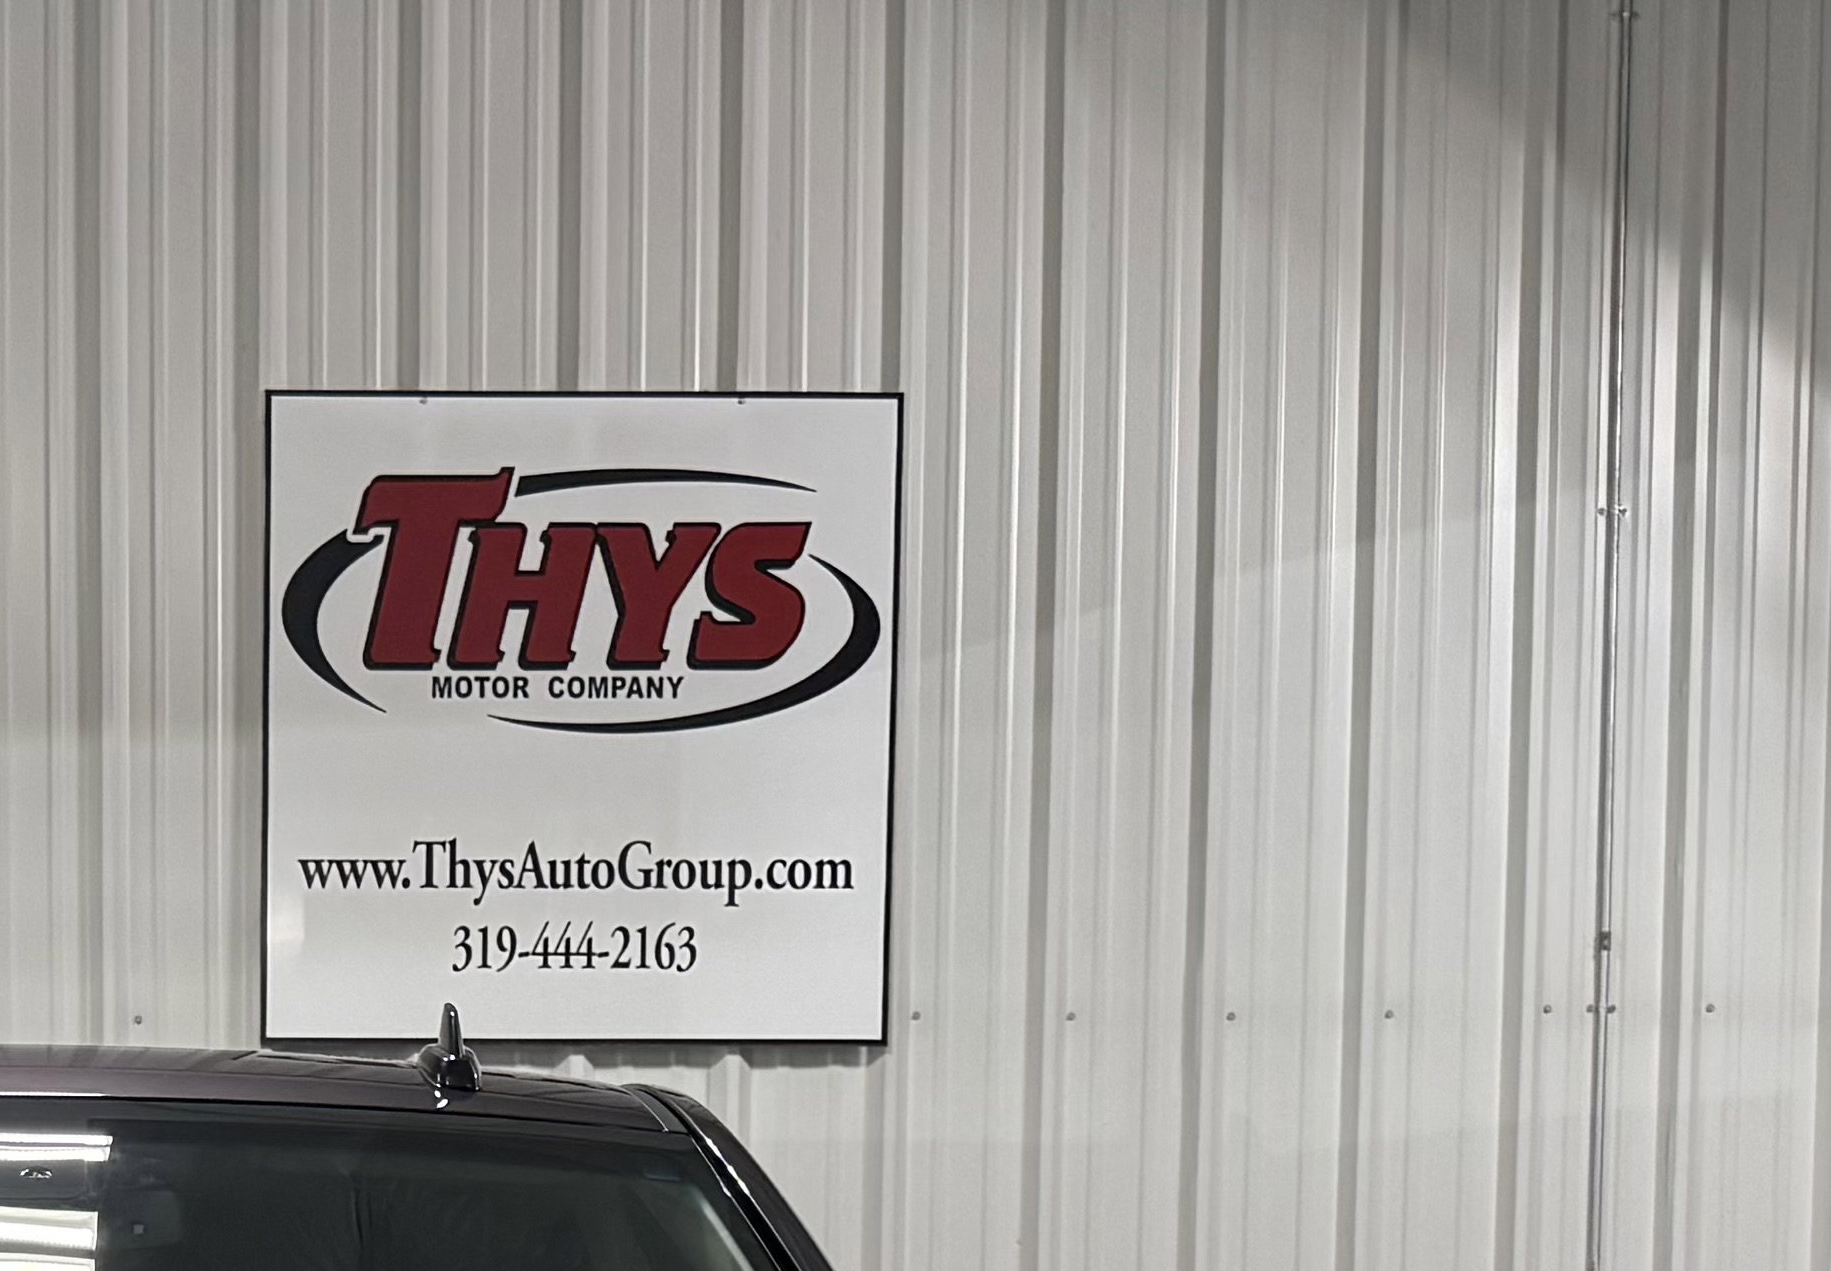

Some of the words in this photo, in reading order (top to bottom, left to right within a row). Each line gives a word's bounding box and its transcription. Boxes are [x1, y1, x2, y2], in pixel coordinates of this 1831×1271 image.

[352, 467, 812, 671] THYS
[431, 676, 530, 700] MOTOR
[548, 675, 685, 700] COMPANY
[298, 837, 855, 908] www.ThysAutoGroup.com
[452, 920, 698, 974] 319-444-2163
